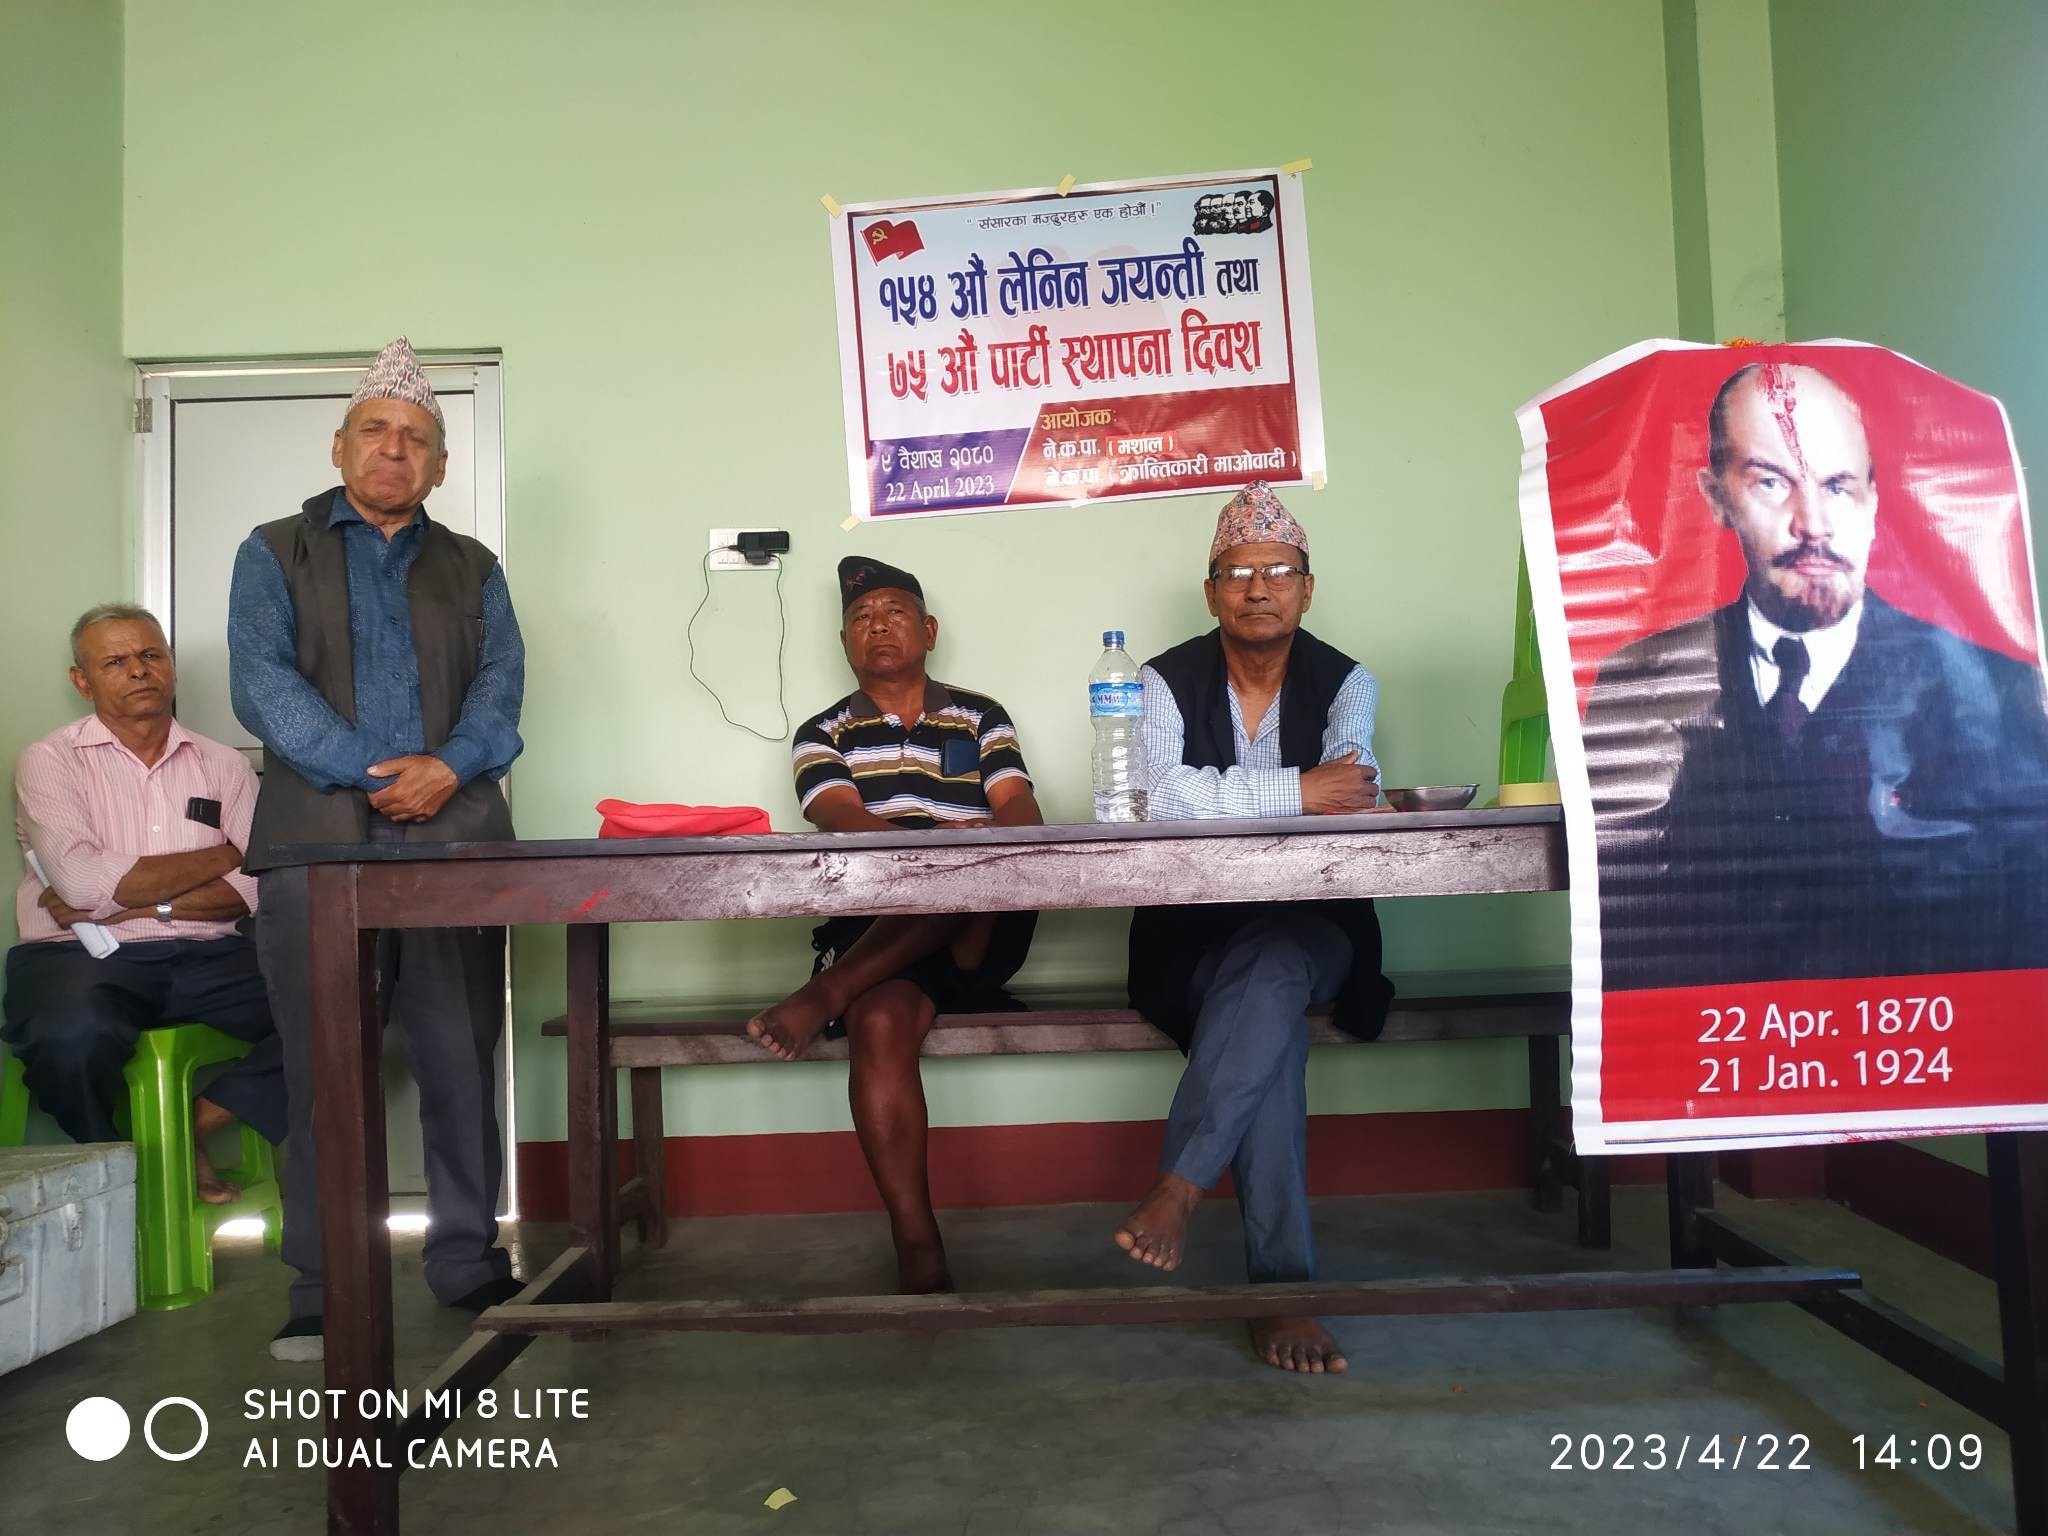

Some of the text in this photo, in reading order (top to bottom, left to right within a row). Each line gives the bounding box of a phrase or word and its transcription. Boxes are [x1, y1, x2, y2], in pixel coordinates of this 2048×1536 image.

[1093, 207, 1114, 219] एक
[879, 274, 938, 327] १५४
[997, 247, 1089, 316] लेनिन
[1098, 236, 1205, 305] जयन्ती
[1215, 258, 1260, 296] तथा
[887, 349, 928, 402] ७५
[987, 323, 1051, 389] पार्टी
[1059, 327, 1172, 387] स्थापना
[1180, 307, 1261, 375] दिवश
[898, 446, 943, 470] वैशाख
[885, 474, 995, 505] 22 April 2023
[1697, 995, 1955, 1048] 22 Apr. 1870
[1697, 1046, 1954, 1093] 21 Jan. 1924
